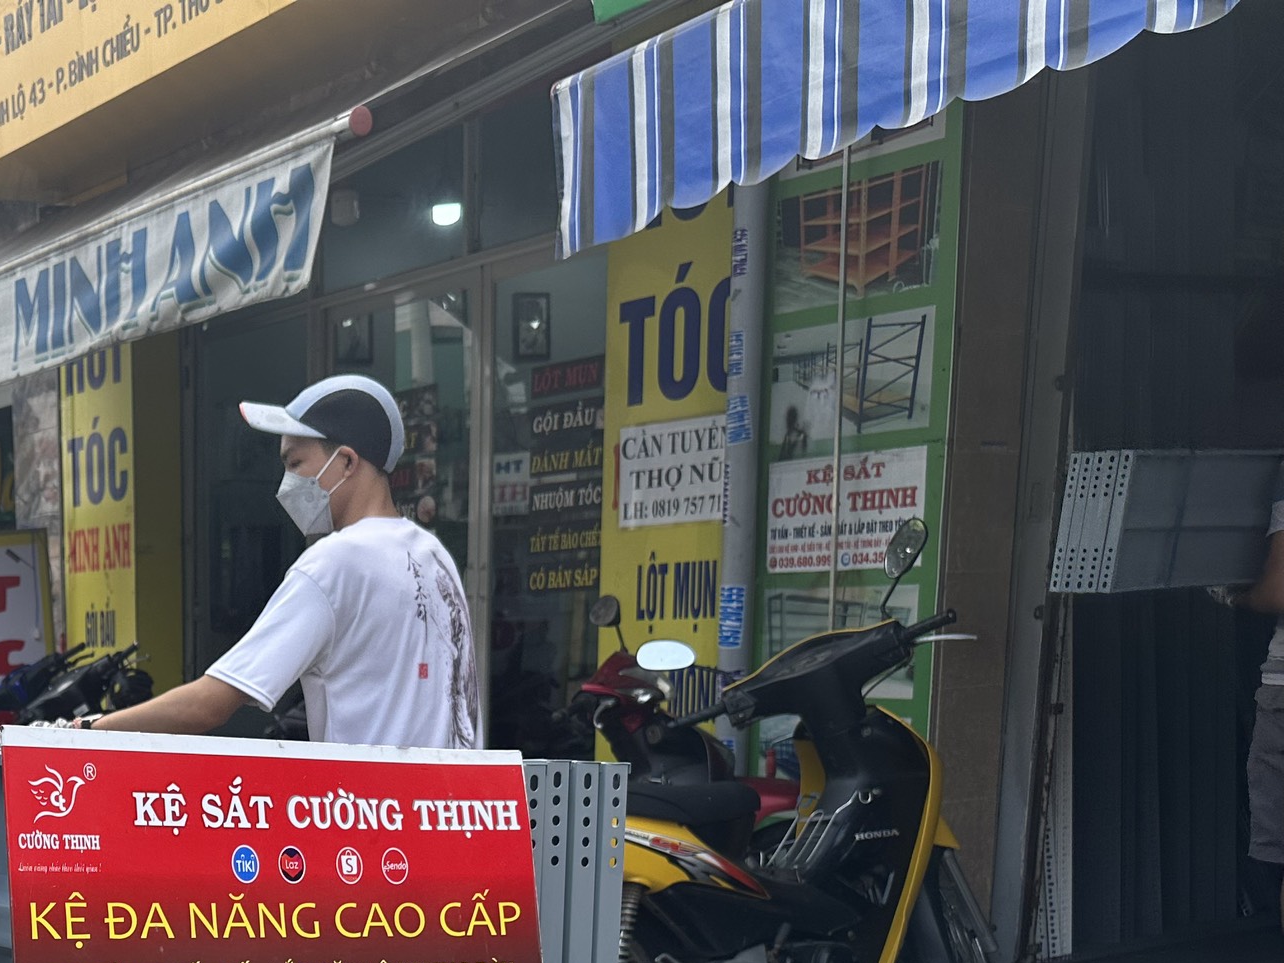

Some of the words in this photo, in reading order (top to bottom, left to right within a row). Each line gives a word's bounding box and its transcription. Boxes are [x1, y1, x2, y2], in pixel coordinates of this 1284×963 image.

[29, 77, 45, 108] 43
[14, 226, 148, 366] MINH
[150, 161, 317, 312] ANH
[533, 408, 559, 435] GỘI
[563, 401, 594, 429] ĐẦU
[622, 429, 663, 460] CẦN
[67, 416, 128, 508] TÓC
[531, 451, 569, 475] ĐÁNH
[806, 464, 833, 486] KỆ
[843, 456, 885, 482] SẮT
[630, 463, 683, 492] THỢ
[532, 489, 574, 513] NHUỘM
[578, 483, 602, 506] TÓC
[623, 501, 649, 521] LH:
[652, 499, 680, 518] 0819
[684, 496, 704, 515] 757
[846, 486, 917, 514] THỊNH
[68, 525, 101, 573] MINH
[103, 521, 132, 569] ANH
[529, 565, 545, 591] CÓ
[548, 564, 572, 589] BÁN
[636, 552, 668, 634] LỘT
[672, 560, 717, 633] MỤN
[131, 783, 188, 836] KỆ
[201, 776, 273, 829] SẮT
[286, 787, 404, 831] CƯỜNG
[413, 799, 521, 839] THỊNH
[18, 829, 60, 850] CƯỜNG
[62, 834, 100, 854] THỊNH
[854, 829, 900, 841] HONDA
[29, 891, 90, 949] KỆ
[104, 903, 175, 940] ĐA
[189, 893, 320, 940] NĂNG
[334, 901, 426, 938] CAO
[439, 889, 522, 938] CẤP
